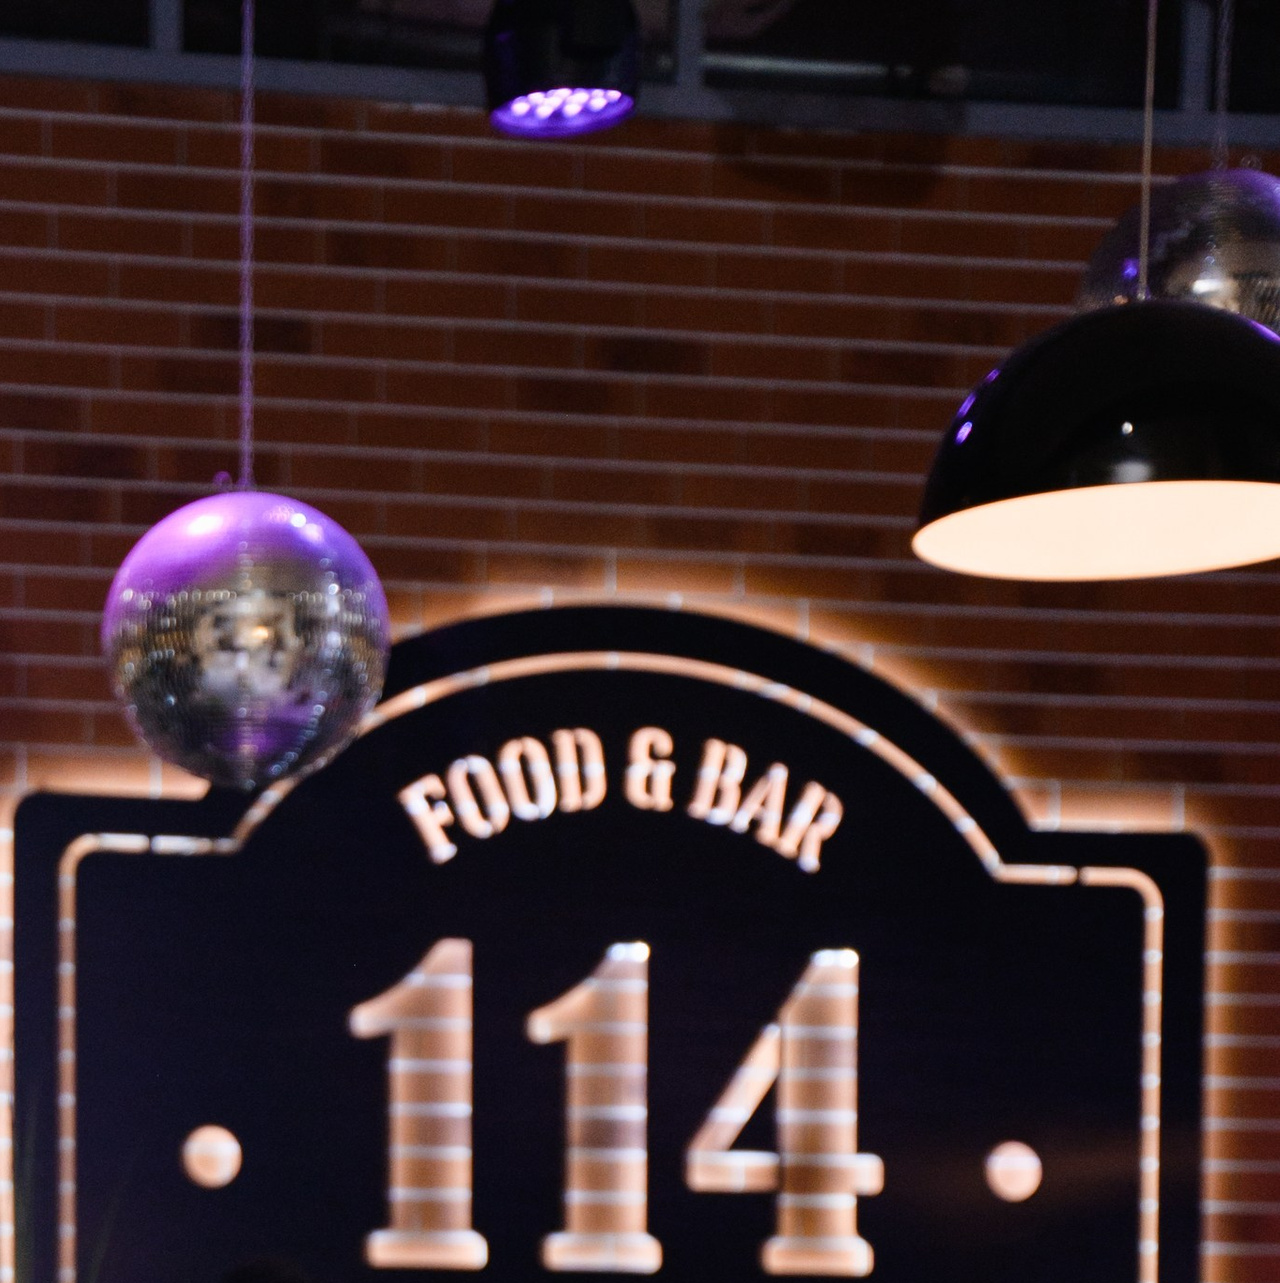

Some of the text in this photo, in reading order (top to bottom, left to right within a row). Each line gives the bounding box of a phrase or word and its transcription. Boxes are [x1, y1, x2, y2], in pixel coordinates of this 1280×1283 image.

[398, 726, 844, 872] FOOD & BAR
[349, 937, 885, 1277] 114
